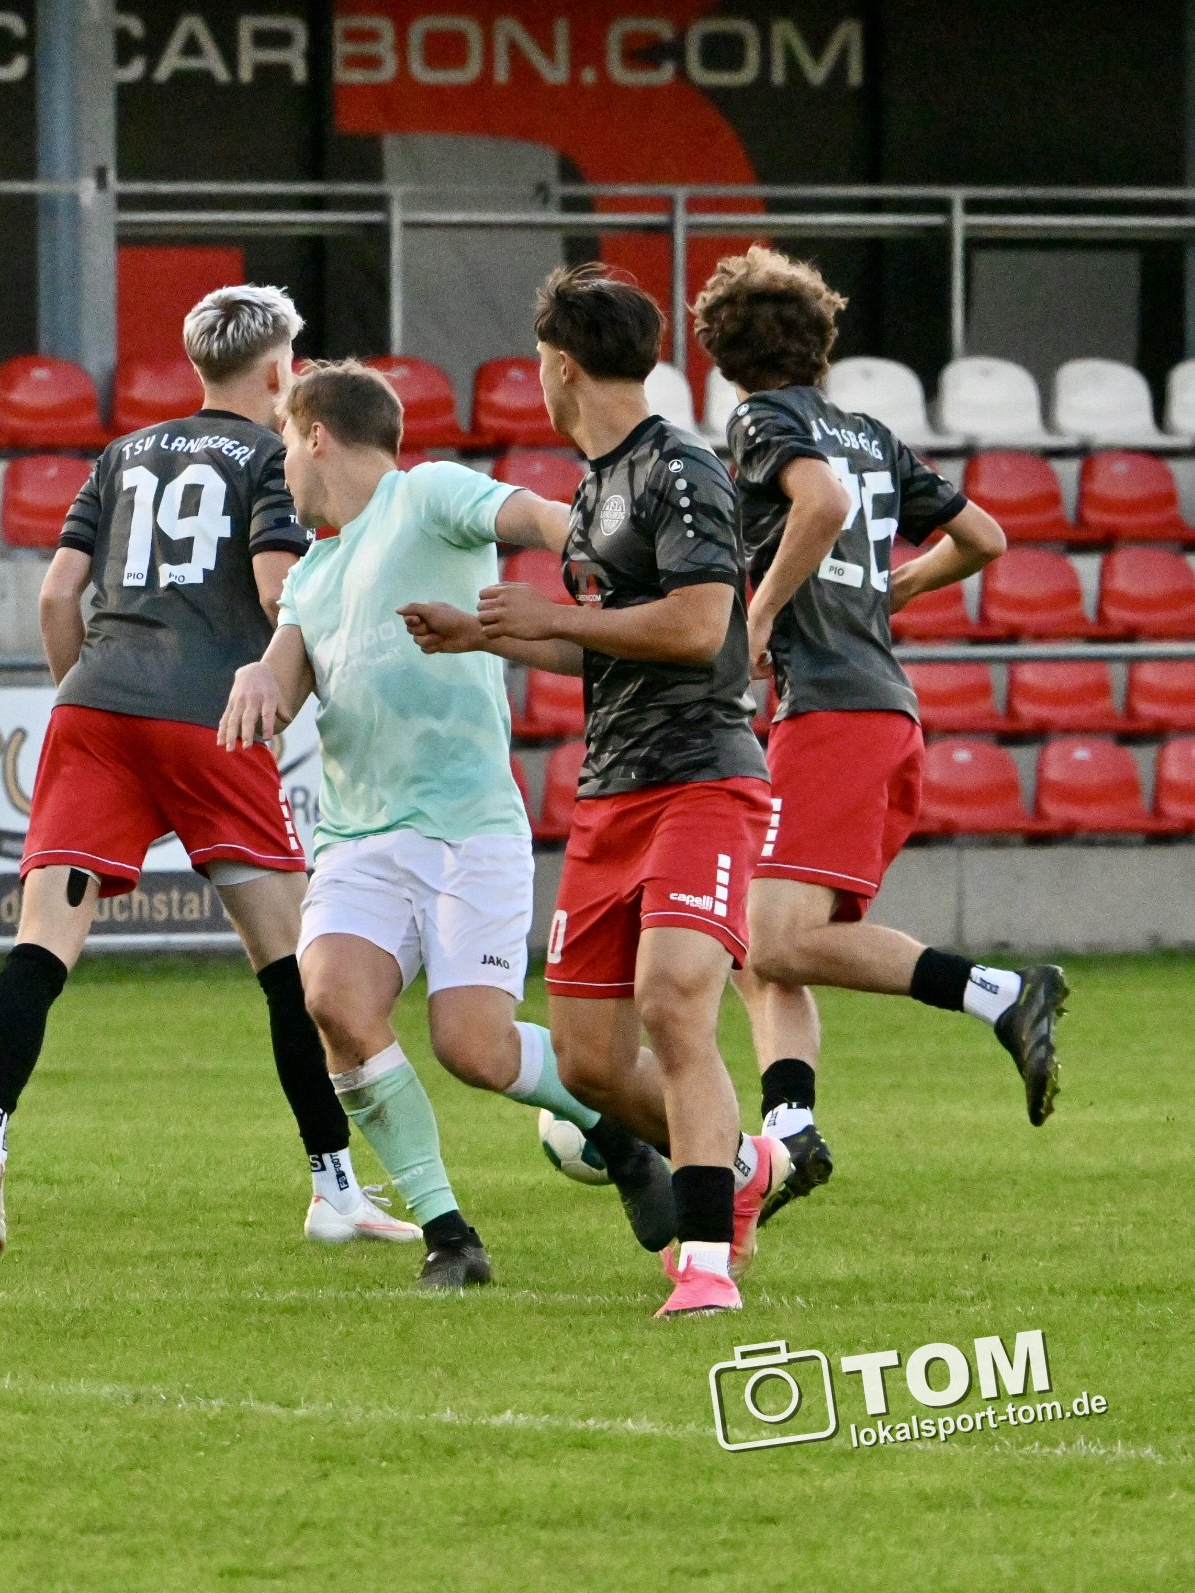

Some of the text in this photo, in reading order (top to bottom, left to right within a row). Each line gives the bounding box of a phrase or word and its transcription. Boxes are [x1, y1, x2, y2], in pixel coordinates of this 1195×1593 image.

[122, 435, 156, 460] TSV
[123, 464, 231, 587] 19
[127, 572, 144, 580] PIO
[829, 566, 844, 576] PIO
[669, 893, 713, 909] capelli
[481, 954, 509, 969] JAKO
